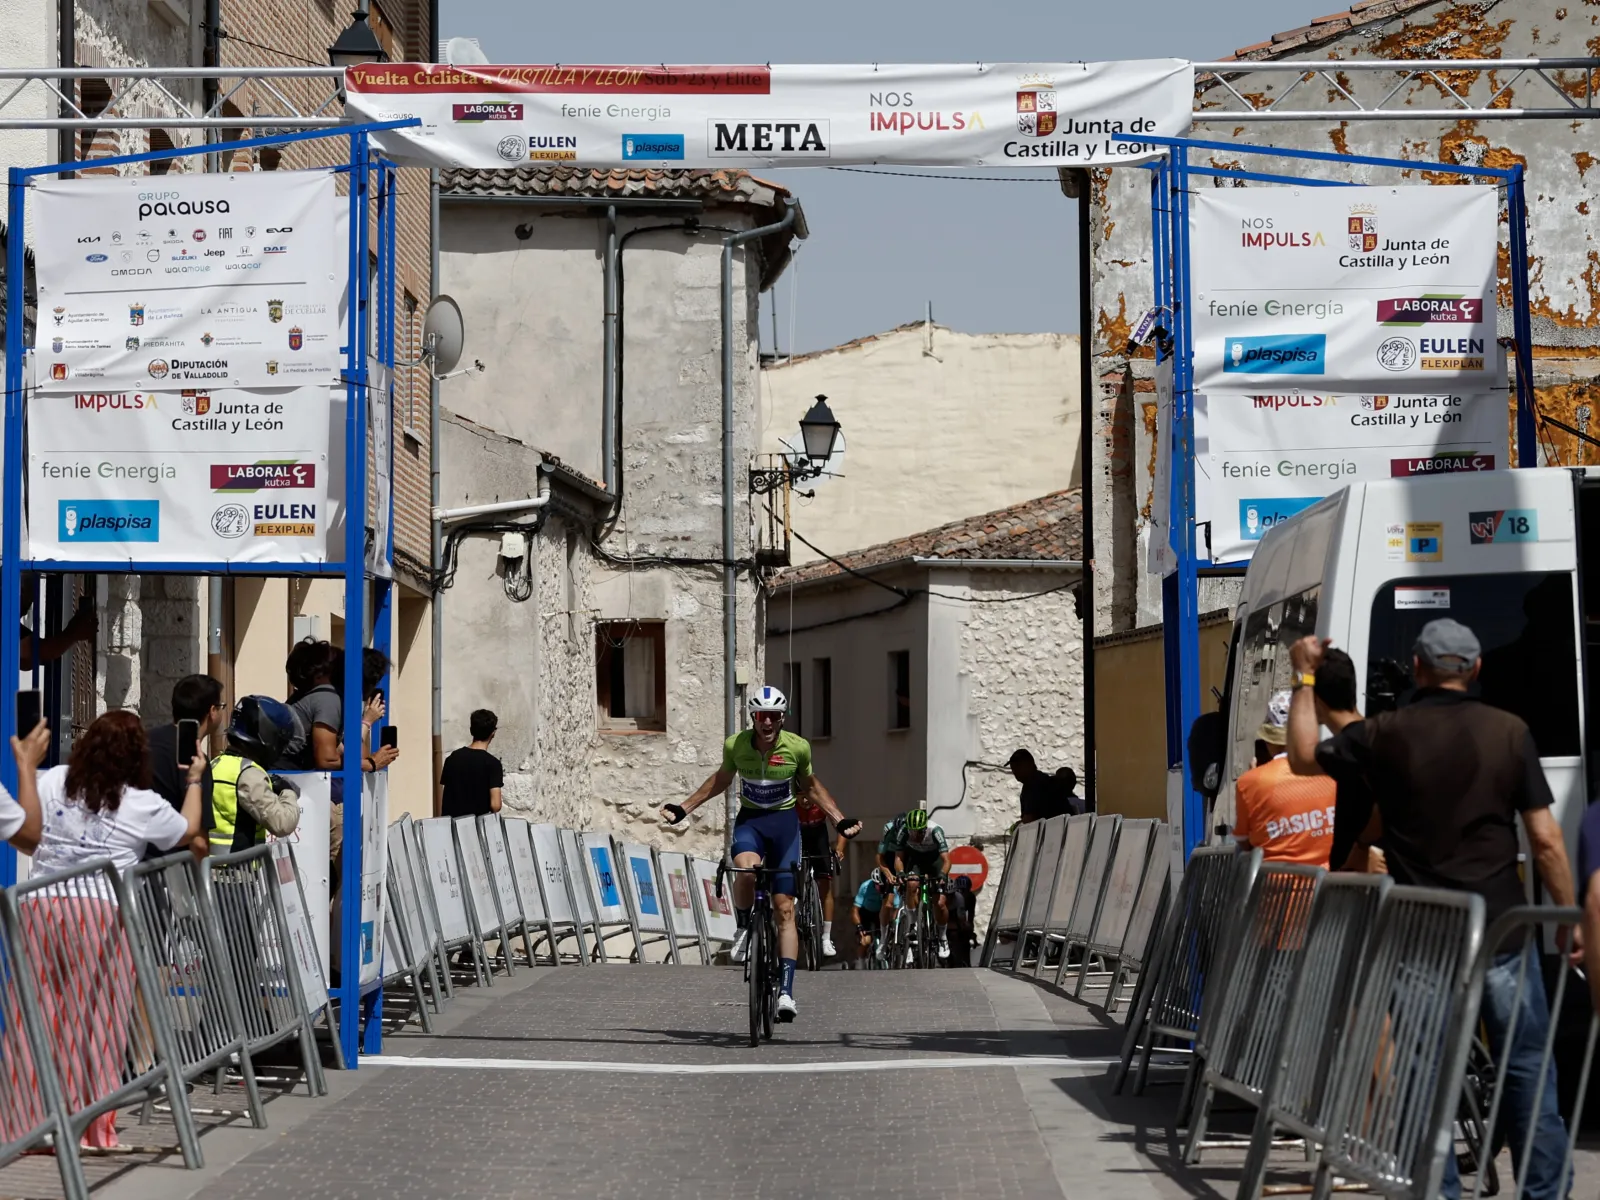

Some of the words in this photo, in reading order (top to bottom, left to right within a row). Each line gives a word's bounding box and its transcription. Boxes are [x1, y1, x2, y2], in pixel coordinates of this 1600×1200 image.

[353, 71, 409, 86] Vuelta
[414, 71, 478, 85] Ciclista
[483, 75, 493, 85] a
[497, 67, 579, 86] CASTILLA
[581, 68, 595, 86] Y
[595, 66, 644, 86] LEÓN
[711, 74, 721, 91] y
[726, 71, 763, 86] Elite
[870, 92, 913, 108] NOS
[464, 105, 507, 114] LABORAL
[870, 111, 985, 135] IMPULSA
[1063, 118, 1123, 135] Junta
[1130, 117, 1157, 133] de
[529, 136, 577, 148] EULEN
[714, 123, 827, 152] META
[634, 141, 680, 155] plaspisa
[1003, 140, 1079, 158] Castilla
[1084, 143, 1098, 161] y
[529, 151, 577, 160] FLEXIPLÁN
[137, 191, 180, 201] GRUPO
[138, 199, 230, 221] palausa
[1241, 217, 1274, 229] NOS
[218, 227, 233, 239] FIAT
[1241, 231, 1326, 251] IMPULSA
[1382, 238, 1426, 252] Junta
[1430, 238, 1450, 250] de
[203, 249, 226, 258] Jeep
[225, 262, 262, 270] walacar
[1338, 255, 1394, 268] Castilla
[1397, 257, 1408, 270] y
[1412, 253, 1450, 267] León
[111, 267, 153, 276] OMODA
[1394, 300, 1457, 312] LABORAL
[1430, 312, 1458, 322] kutxa
[1137, 316, 1151, 335] LYNX
[1419, 338, 1484, 354] EULEN
[1245, 345, 1318, 364] plaspisa
[171, 358, 228, 369] DIPUTACIÓN
[1420, 357, 1484, 370] FLEXIPLÁN
[184, 371, 228, 379] VALLADOLID
[75, 394, 158, 412] IMPULSA
[215, 402, 260, 415] Junta
[264, 402, 284, 415] de
[1393, 395, 1438, 408] Junta
[1441, 395, 1462, 407] de
[171, 418, 228, 431] Castilla
[231, 420, 242, 434] y
[245, 416, 284, 431] León
[1350, 413, 1406, 427] Castilla
[1410, 415, 1420, 428] y
[1423, 411, 1462, 425] León
[227, 465, 291, 478] LABORAL
[1408, 458, 1470, 472] LABORAL
[264, 477, 291, 488] kutxa
[253, 504, 316, 520] EULEN
[79, 513, 152, 532] plaspisa
[1508, 516, 1530, 535] 18
[254, 524, 315, 537] FLEXIPLÁN
[1418, 538, 1430, 553] P
